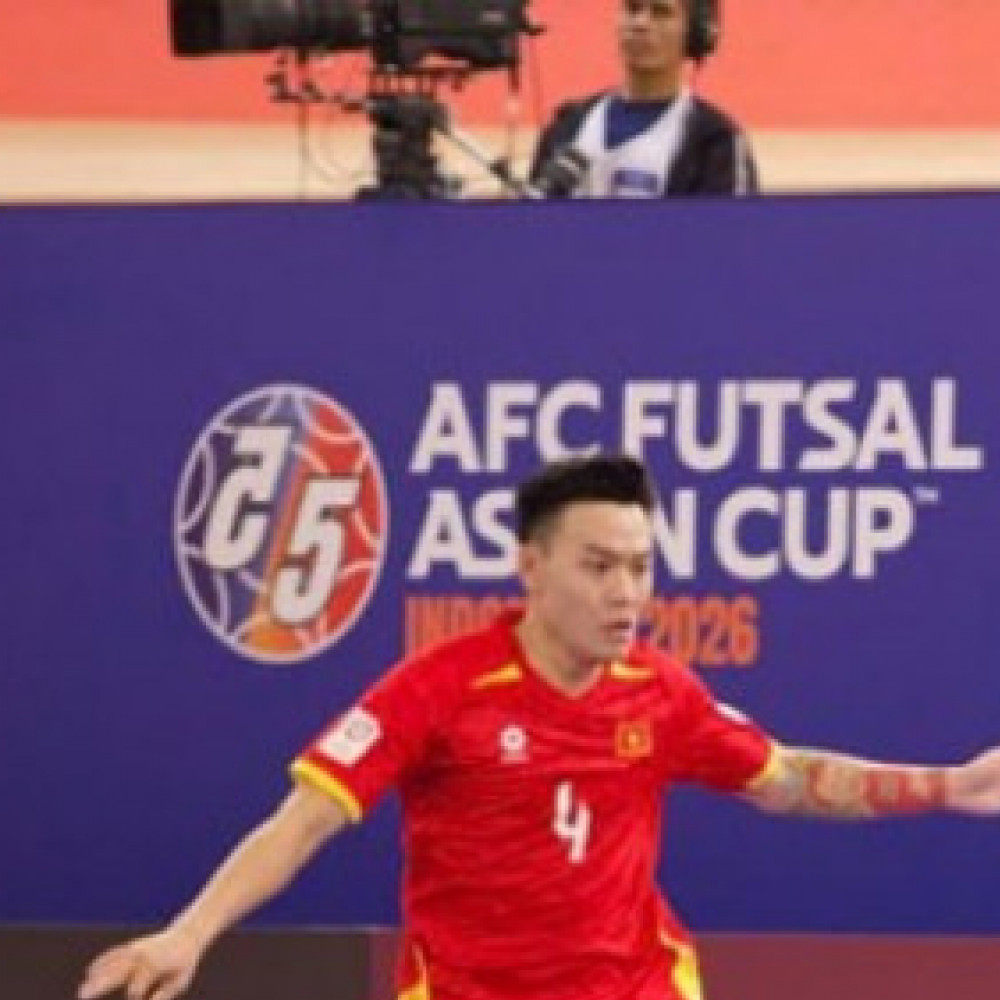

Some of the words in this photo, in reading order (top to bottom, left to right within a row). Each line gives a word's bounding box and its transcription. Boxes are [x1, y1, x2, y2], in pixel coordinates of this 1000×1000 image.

[408, 379, 602, 473] AFC
[623, 378, 984, 473] FUTSAL
[405, 488, 697, 579] ASN
[553, 780, 591, 864] 4
